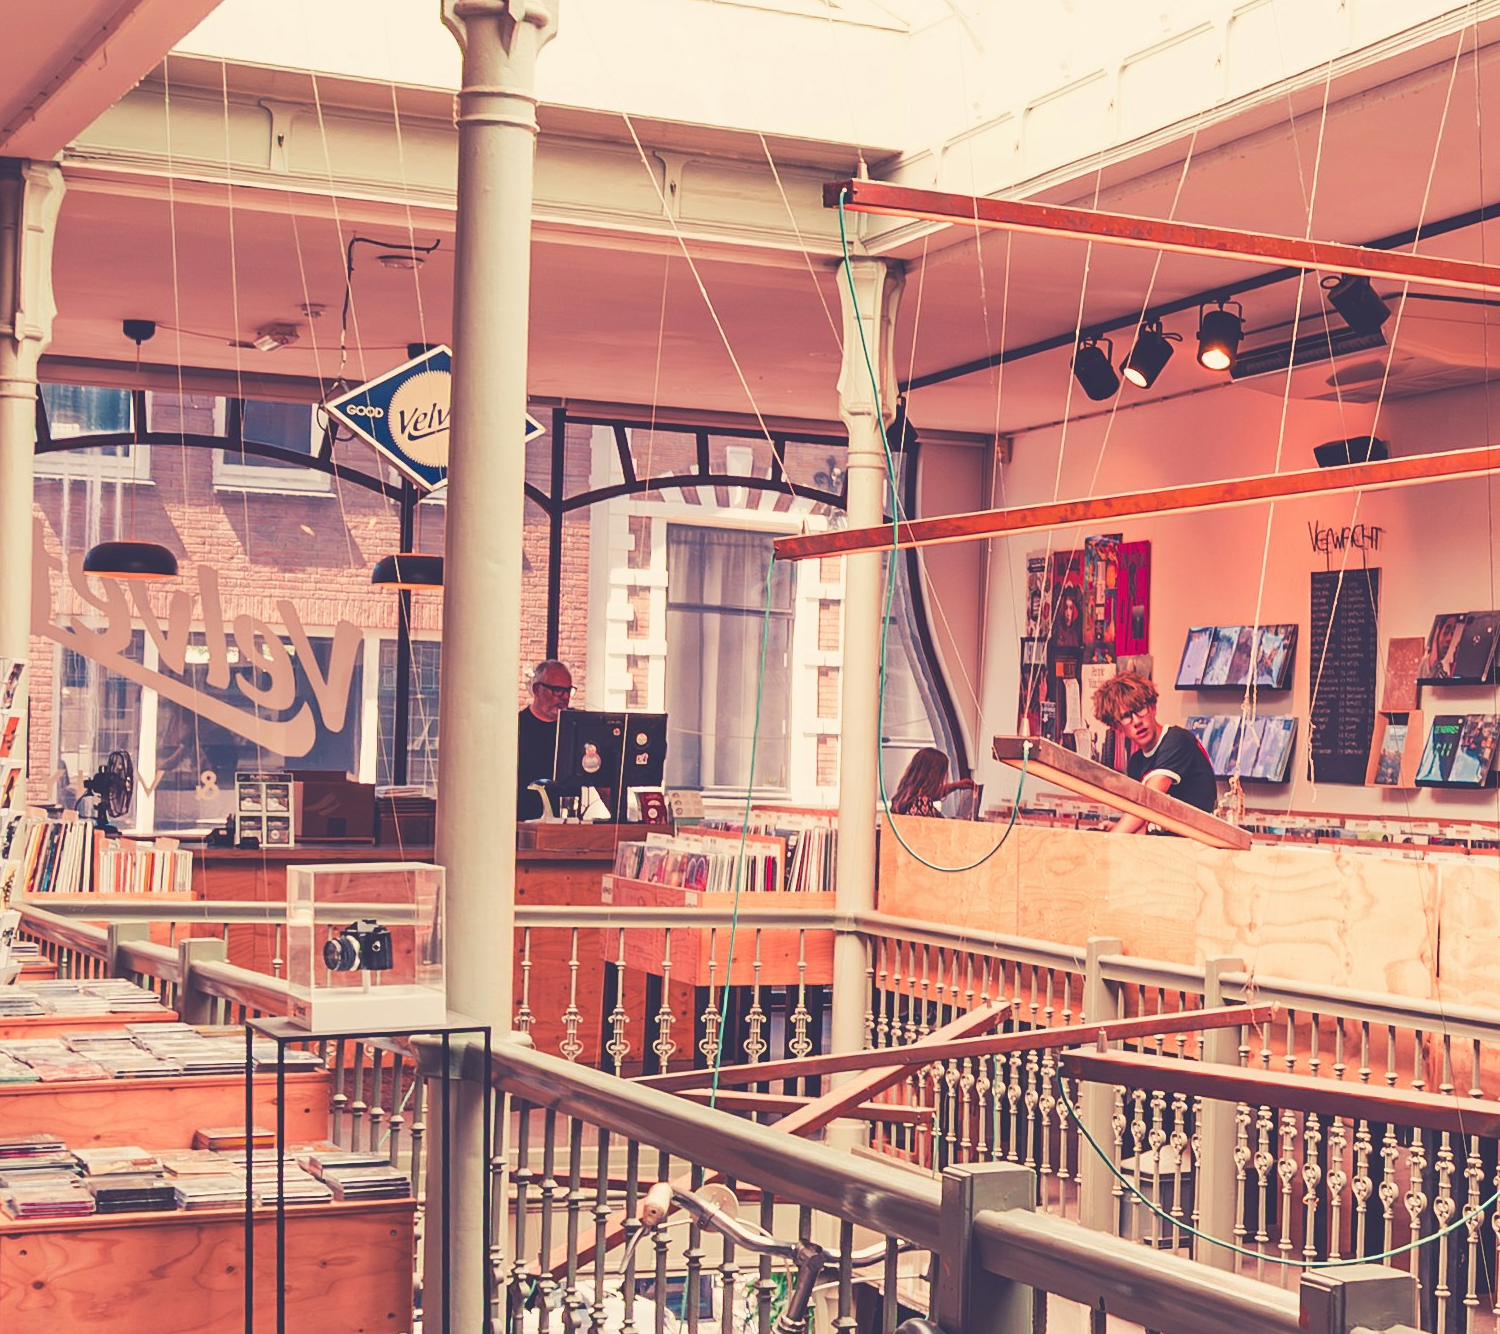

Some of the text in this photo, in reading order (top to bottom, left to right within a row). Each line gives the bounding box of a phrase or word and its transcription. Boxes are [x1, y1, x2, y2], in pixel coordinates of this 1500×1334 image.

[346, 404, 384, 418] GOOD
[399, 402, 450, 435] Velv
[1308, 519, 1386, 553] VERWACHT
